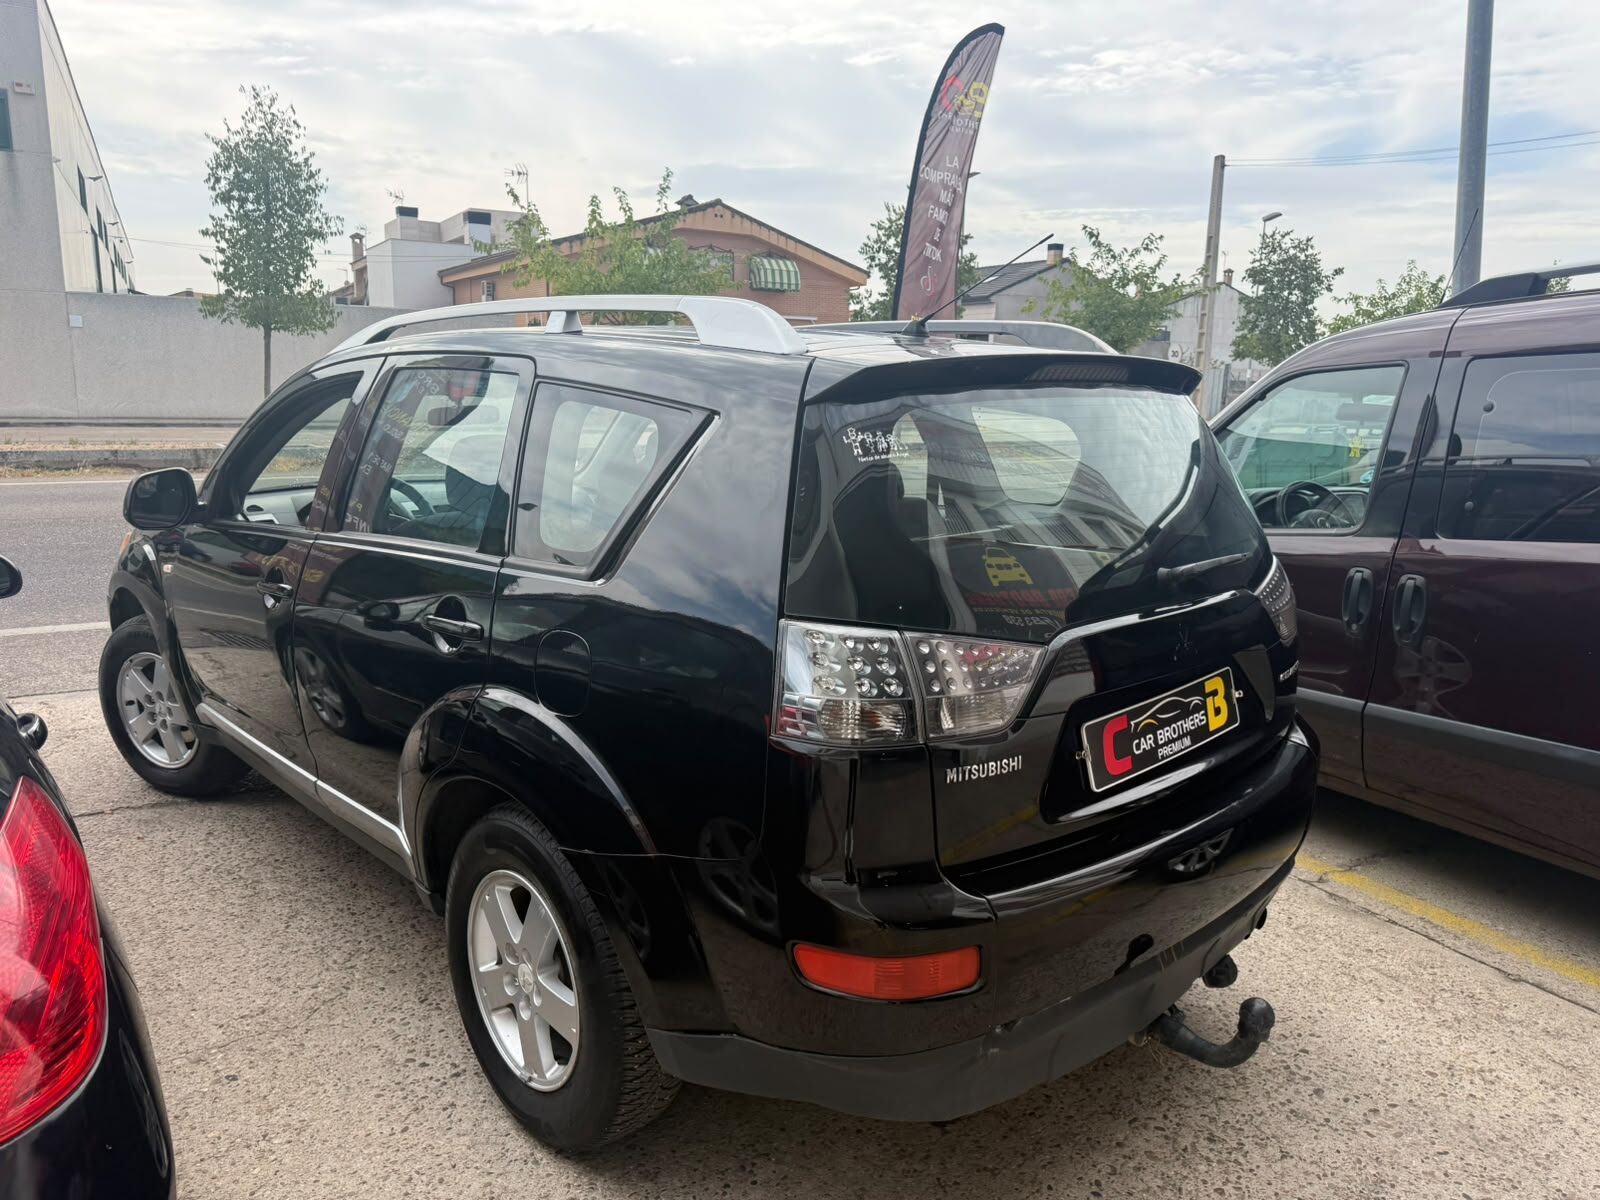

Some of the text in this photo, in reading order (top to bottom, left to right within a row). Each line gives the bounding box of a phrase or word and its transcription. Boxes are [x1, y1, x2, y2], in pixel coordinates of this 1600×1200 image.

[946, 155, 959, 169] LA
[1204, 676, 1228, 732] B
[1103, 714, 1132, 776] C
[1132, 710, 1207, 755] CAR BROTHERS
[1157, 735, 1191, 759] PREMIUM
[946, 755, 1022, 784] MITSUBISHI
